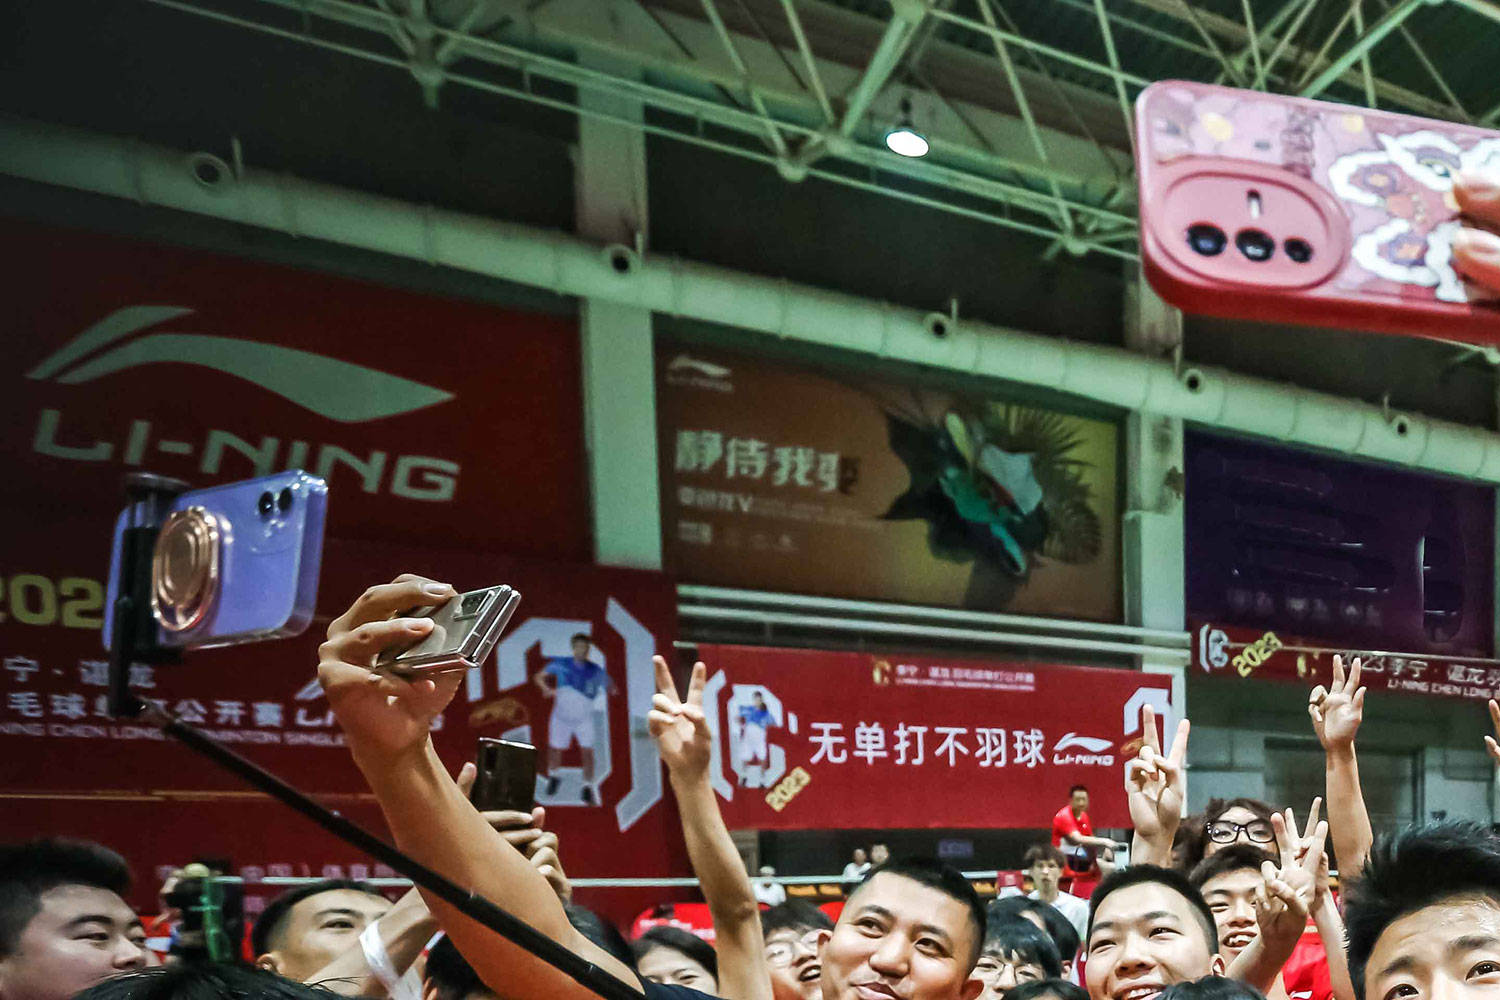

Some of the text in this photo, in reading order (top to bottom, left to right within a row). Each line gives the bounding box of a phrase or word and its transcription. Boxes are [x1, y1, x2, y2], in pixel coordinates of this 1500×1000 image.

[33, 409, 461, 501] LI-NING
[1232, 631, 1283, 678] 2023
[808, 721, 1046, 768] 无单打不羽球
[1053, 753, 1114, 767] LI-NING
